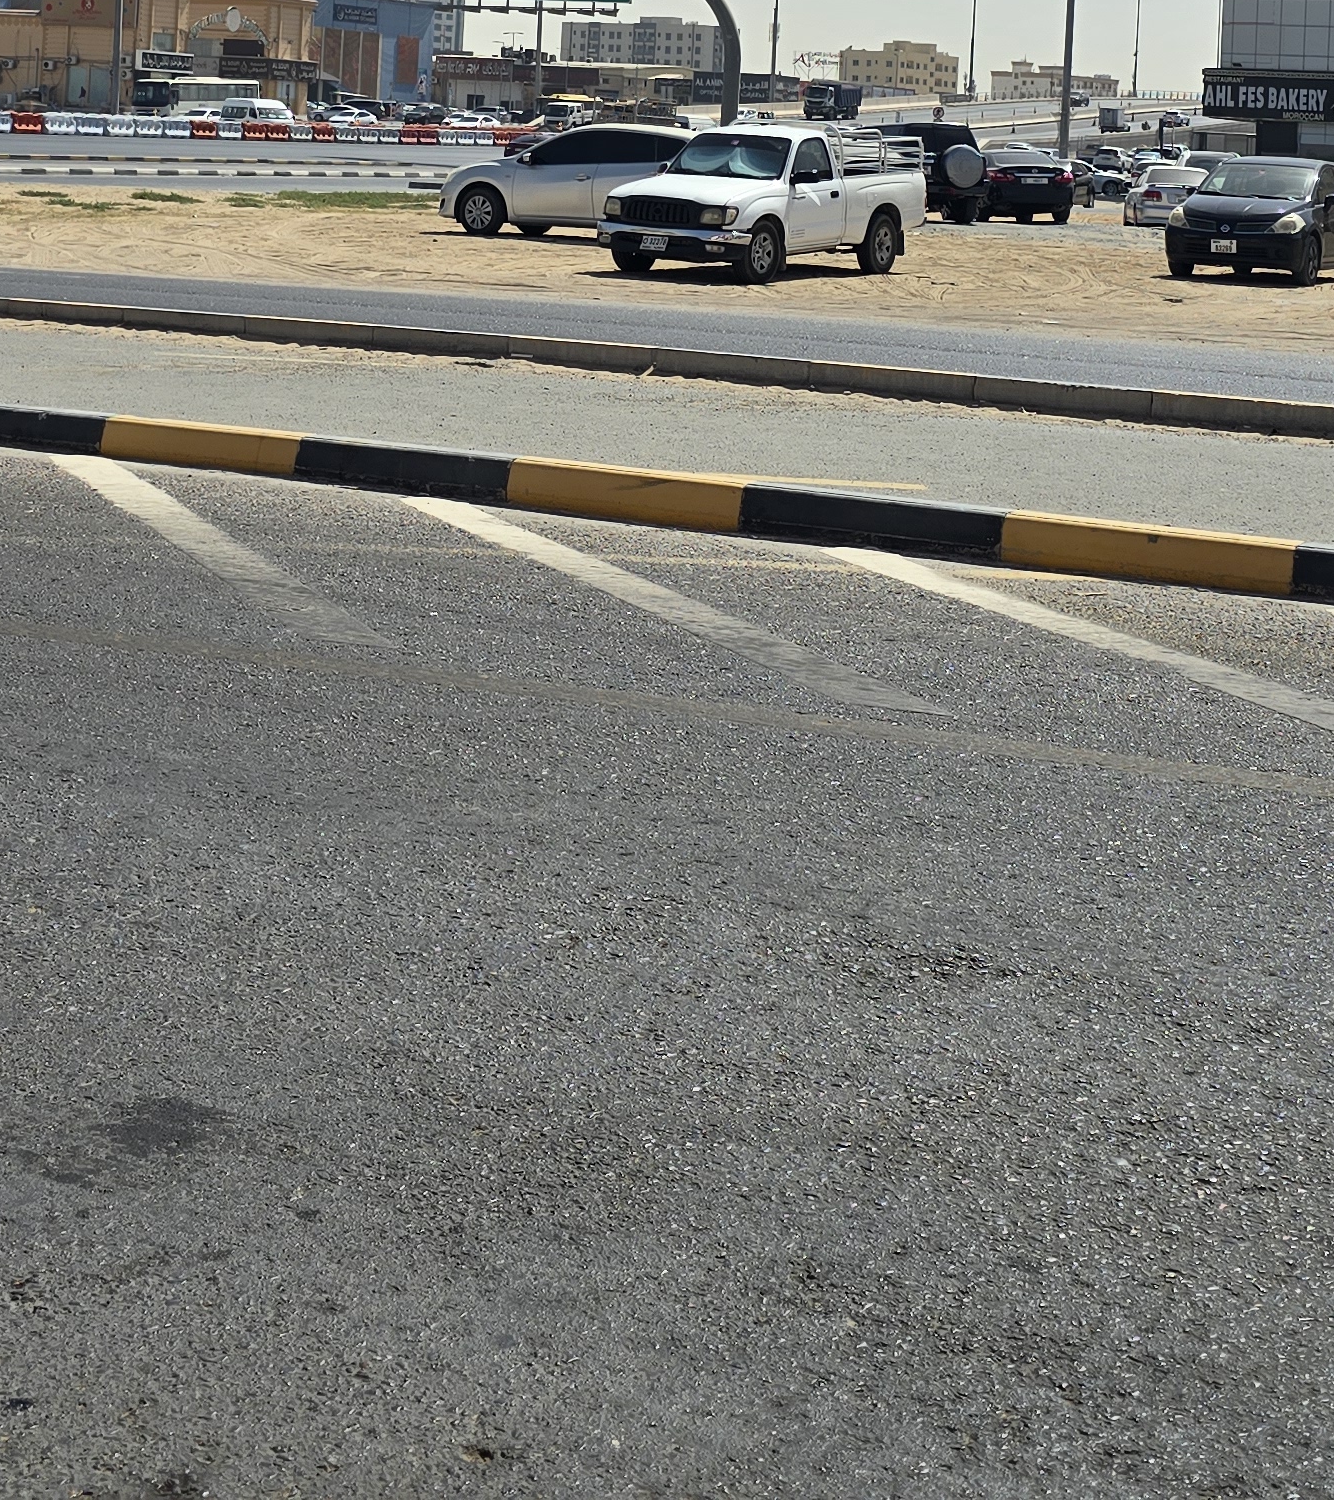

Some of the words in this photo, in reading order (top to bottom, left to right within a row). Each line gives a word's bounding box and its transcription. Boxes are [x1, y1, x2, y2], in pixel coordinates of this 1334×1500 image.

[1204, 84, 1235, 108] AHL
[1238, 86, 1265, 109] FES
[1268, 86, 1328, 112] BAKERY
[1282, 111, 1325, 121] MOROCCAN
